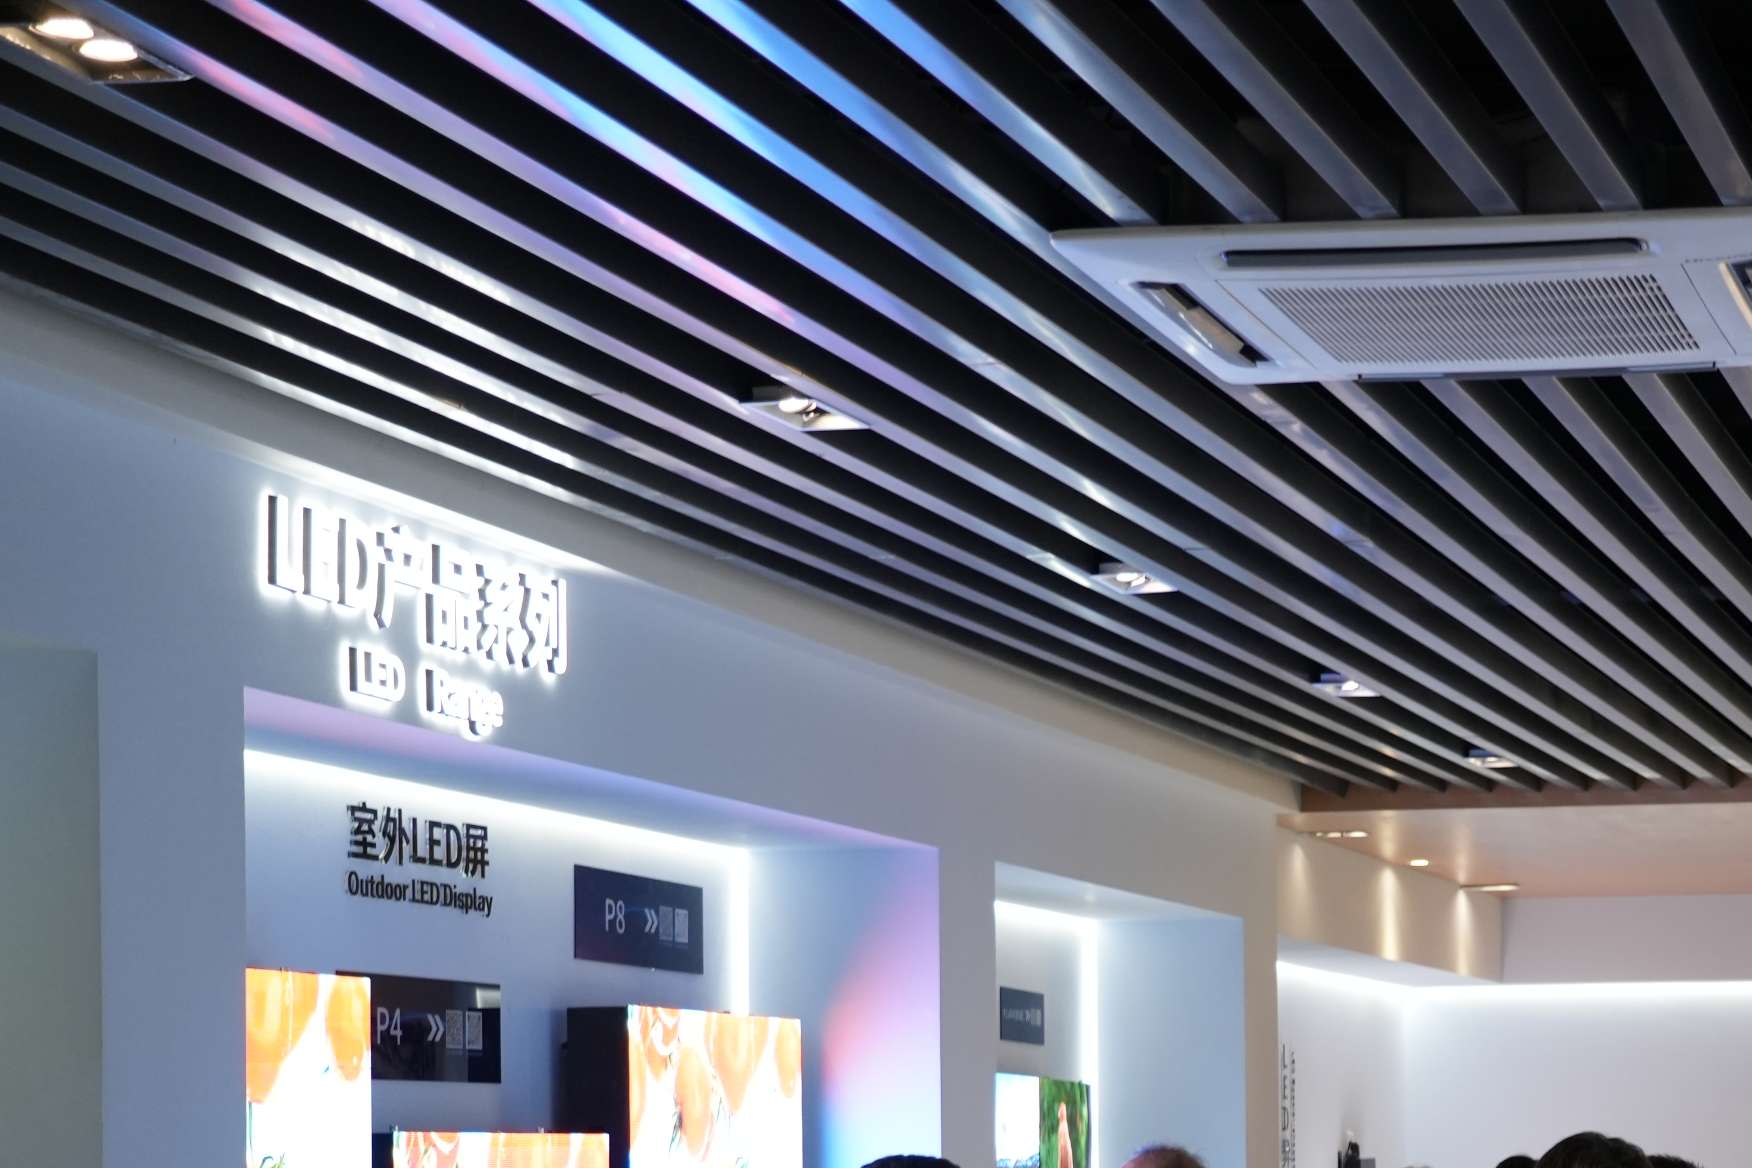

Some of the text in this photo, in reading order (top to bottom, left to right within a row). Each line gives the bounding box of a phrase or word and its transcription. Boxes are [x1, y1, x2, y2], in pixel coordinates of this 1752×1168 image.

[267, 494, 568, 675] LED产品系列
[348, 645, 504, 737] LED Range
[347, 801, 490, 880] 室外LED屏
[346, 870, 493, 919] Outdoor LED Display
[604, 897, 626, 935] P8
[376, 1005, 402, 1046] P4
